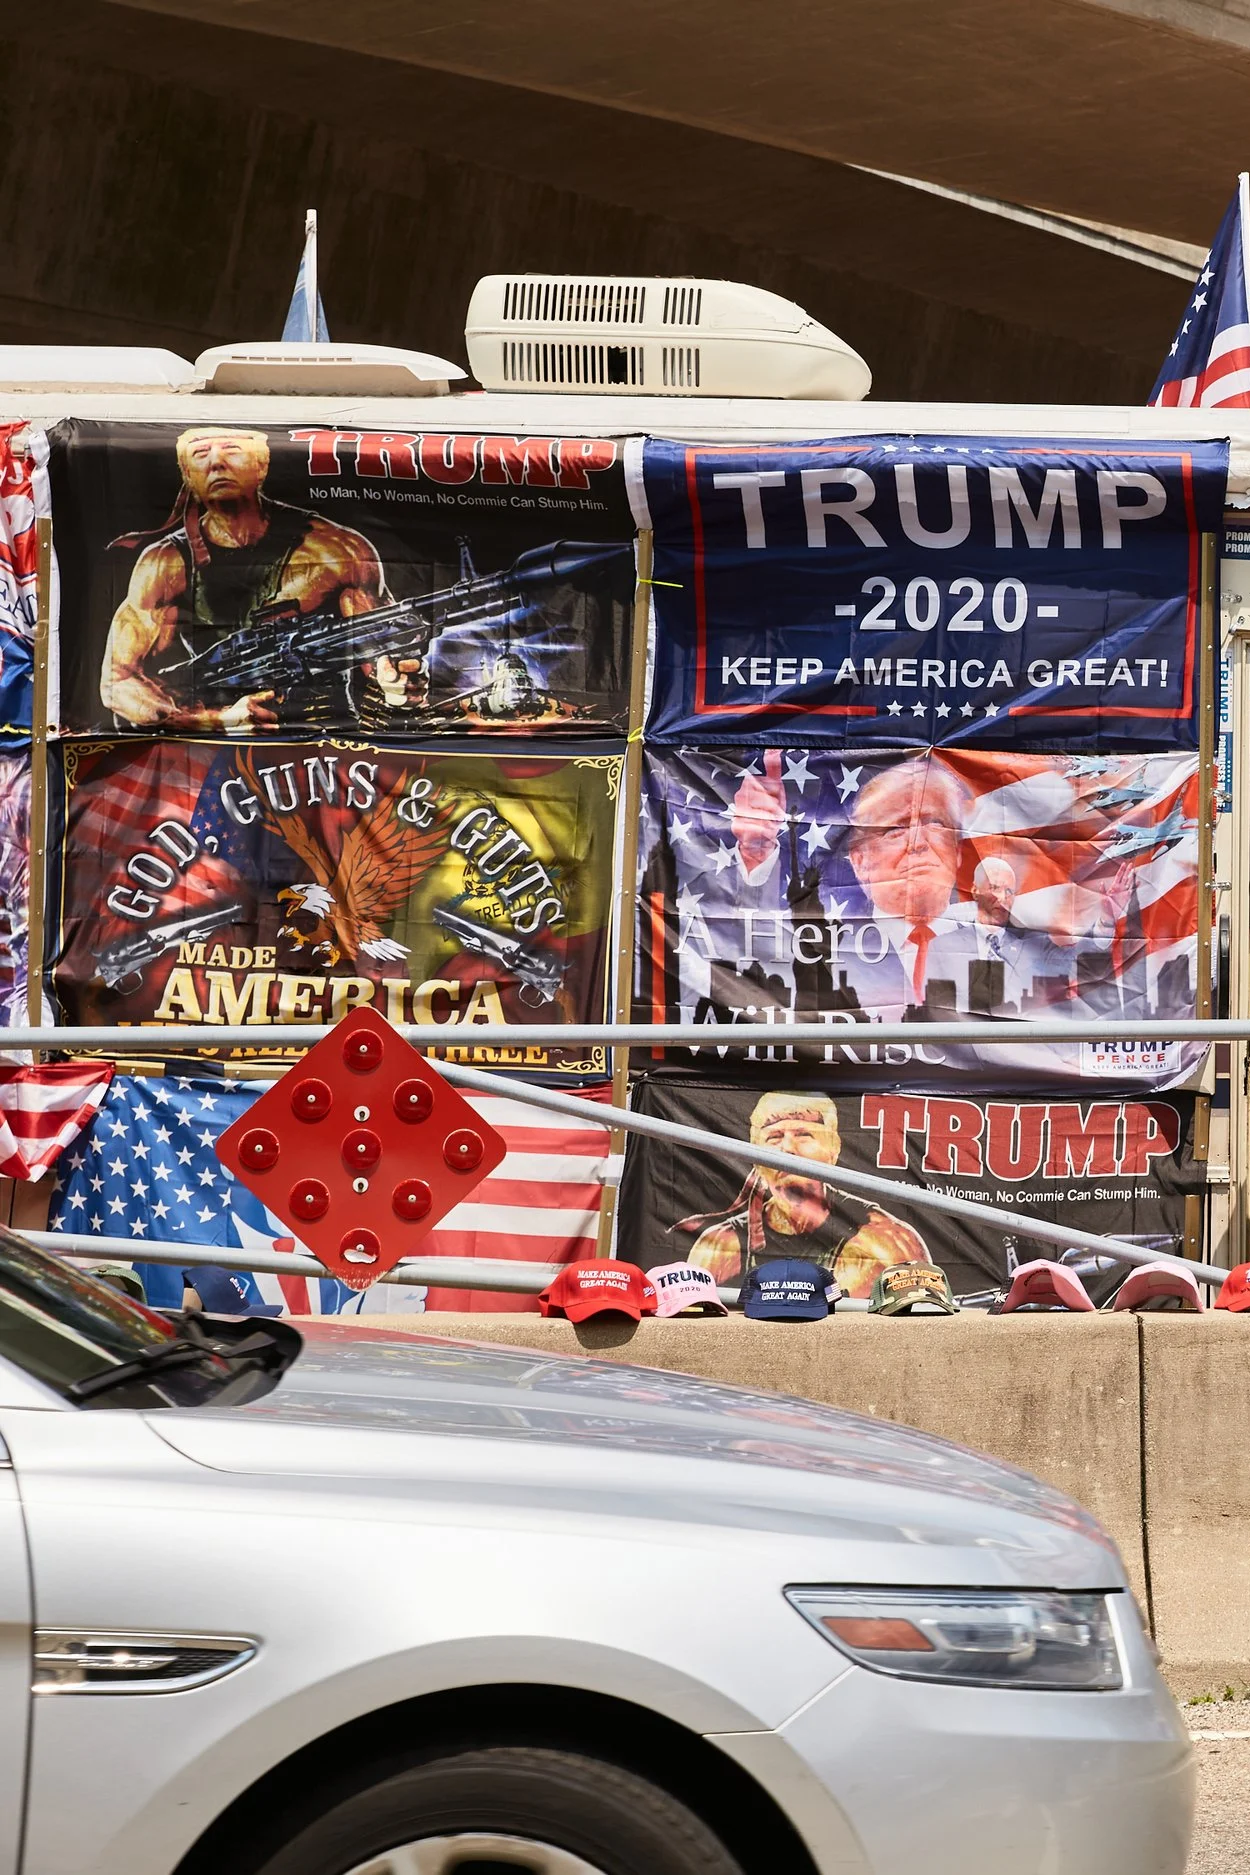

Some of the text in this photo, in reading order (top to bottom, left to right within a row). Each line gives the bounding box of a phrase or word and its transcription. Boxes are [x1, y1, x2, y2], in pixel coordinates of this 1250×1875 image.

[289, 428, 617, 490] TRUMP
[310, 488, 608, 511] No Man, No Woman, No Commie Can Stump Him.
[713, 463, 1167, 549] TRUMP
[834, 576, 1059, 633] -2020-
[722, 656, 1168, 688] KEEP AMERICA GREAT!
[107, 756, 566, 935] GOD, GUNS & GUTS
[674, 909, 890, 964] A Hero
[176, 942, 277, 969] MADE
[155, 968, 510, 1026] AMERICA
[674, 1003, 799, 1063] Will
[1088, 1041, 1174, 1053] TRUMP
[1097, 1053, 1166, 1063] PENCE
[860, 1092, 1181, 1182] TRUMP
[926, 1184, 943, 1195] No
[946, 1185, 993, 1204] Woman,
[996, 1190, 1014, 1204] No
[1016, 1189, 1065, 1203] Commie
[1067, 1188, 1091, 1201] Can
[1094, 1187, 1132, 1203] Stump
[1134, 1186, 1161, 1199] Him.
[577, 1270, 631, 1282] MAKE AMERICA
[580, 1279, 628, 1290] GREAT AGAIN
[657, 1269, 712, 1288] TRUMP
[760, 1281, 816, 1292] MAKE AMERICA
[892, 1279, 919, 1291] GREAT
[911, 1269, 944, 1283] AMERICA
[762, 1291, 811, 1302] GREAT AGAIN
